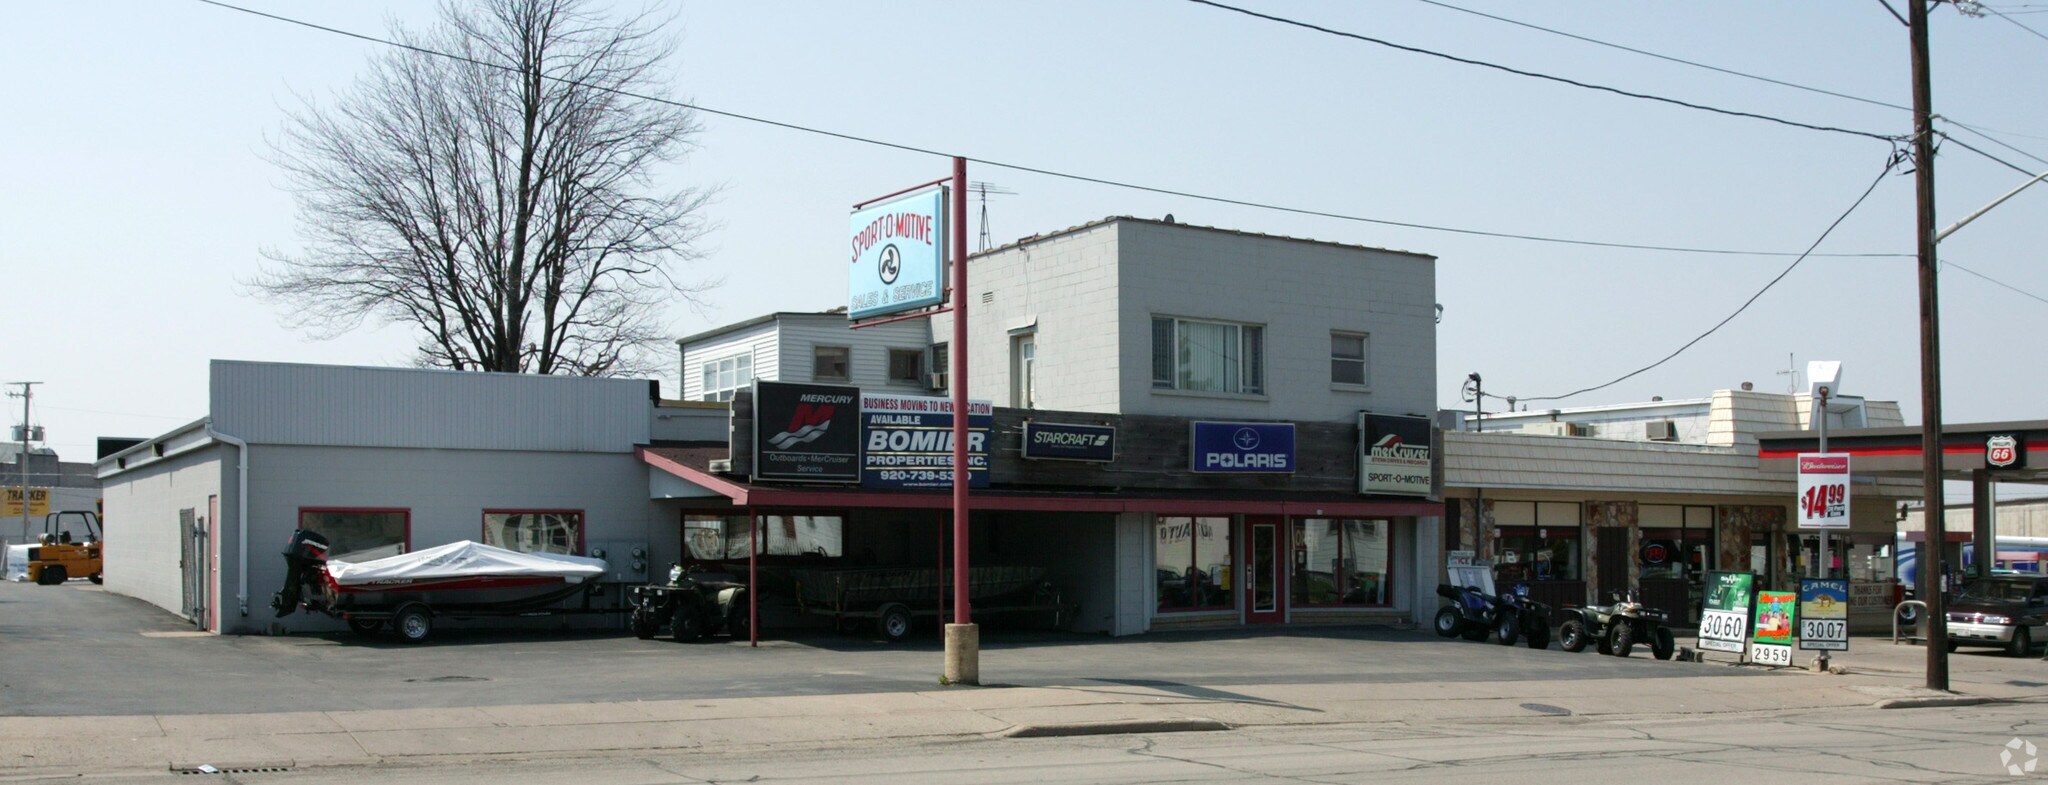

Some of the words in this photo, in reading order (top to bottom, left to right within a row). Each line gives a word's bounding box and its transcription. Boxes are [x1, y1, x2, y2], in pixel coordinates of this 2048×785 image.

[851, 289, 879, 311] SALES
[881, 289, 889, 304] &
[893, 280, 934, 303] SERVICE
[801, 393, 854, 404] MERCURY
[864, 397, 898, 410] BUSINESS
[901, 399, 928, 412] MOVING
[929, 401, 939, 412] TO
[940, 402, 954, 412] NEW
[967, 403, 991, 414] CATION
[870, 414, 921, 425] AVAILABLE
[1034, 431, 1096, 446] STARCRAFT
[769, 453, 808, 463] Outboards
[1992, 448, 2010, 460] 66
[866, 455, 954, 466] PROPERTIES
[1206, 452, 1287, 468] POLARIS
[797, 464, 824, 473] Service
[1801, 461, 1847, 471] Budweiser
[880, 470, 972, 481] 920-739-53
[7, 490, 47, 501] TRAKER
[1802, 581, 1846, 593] CAMEL
